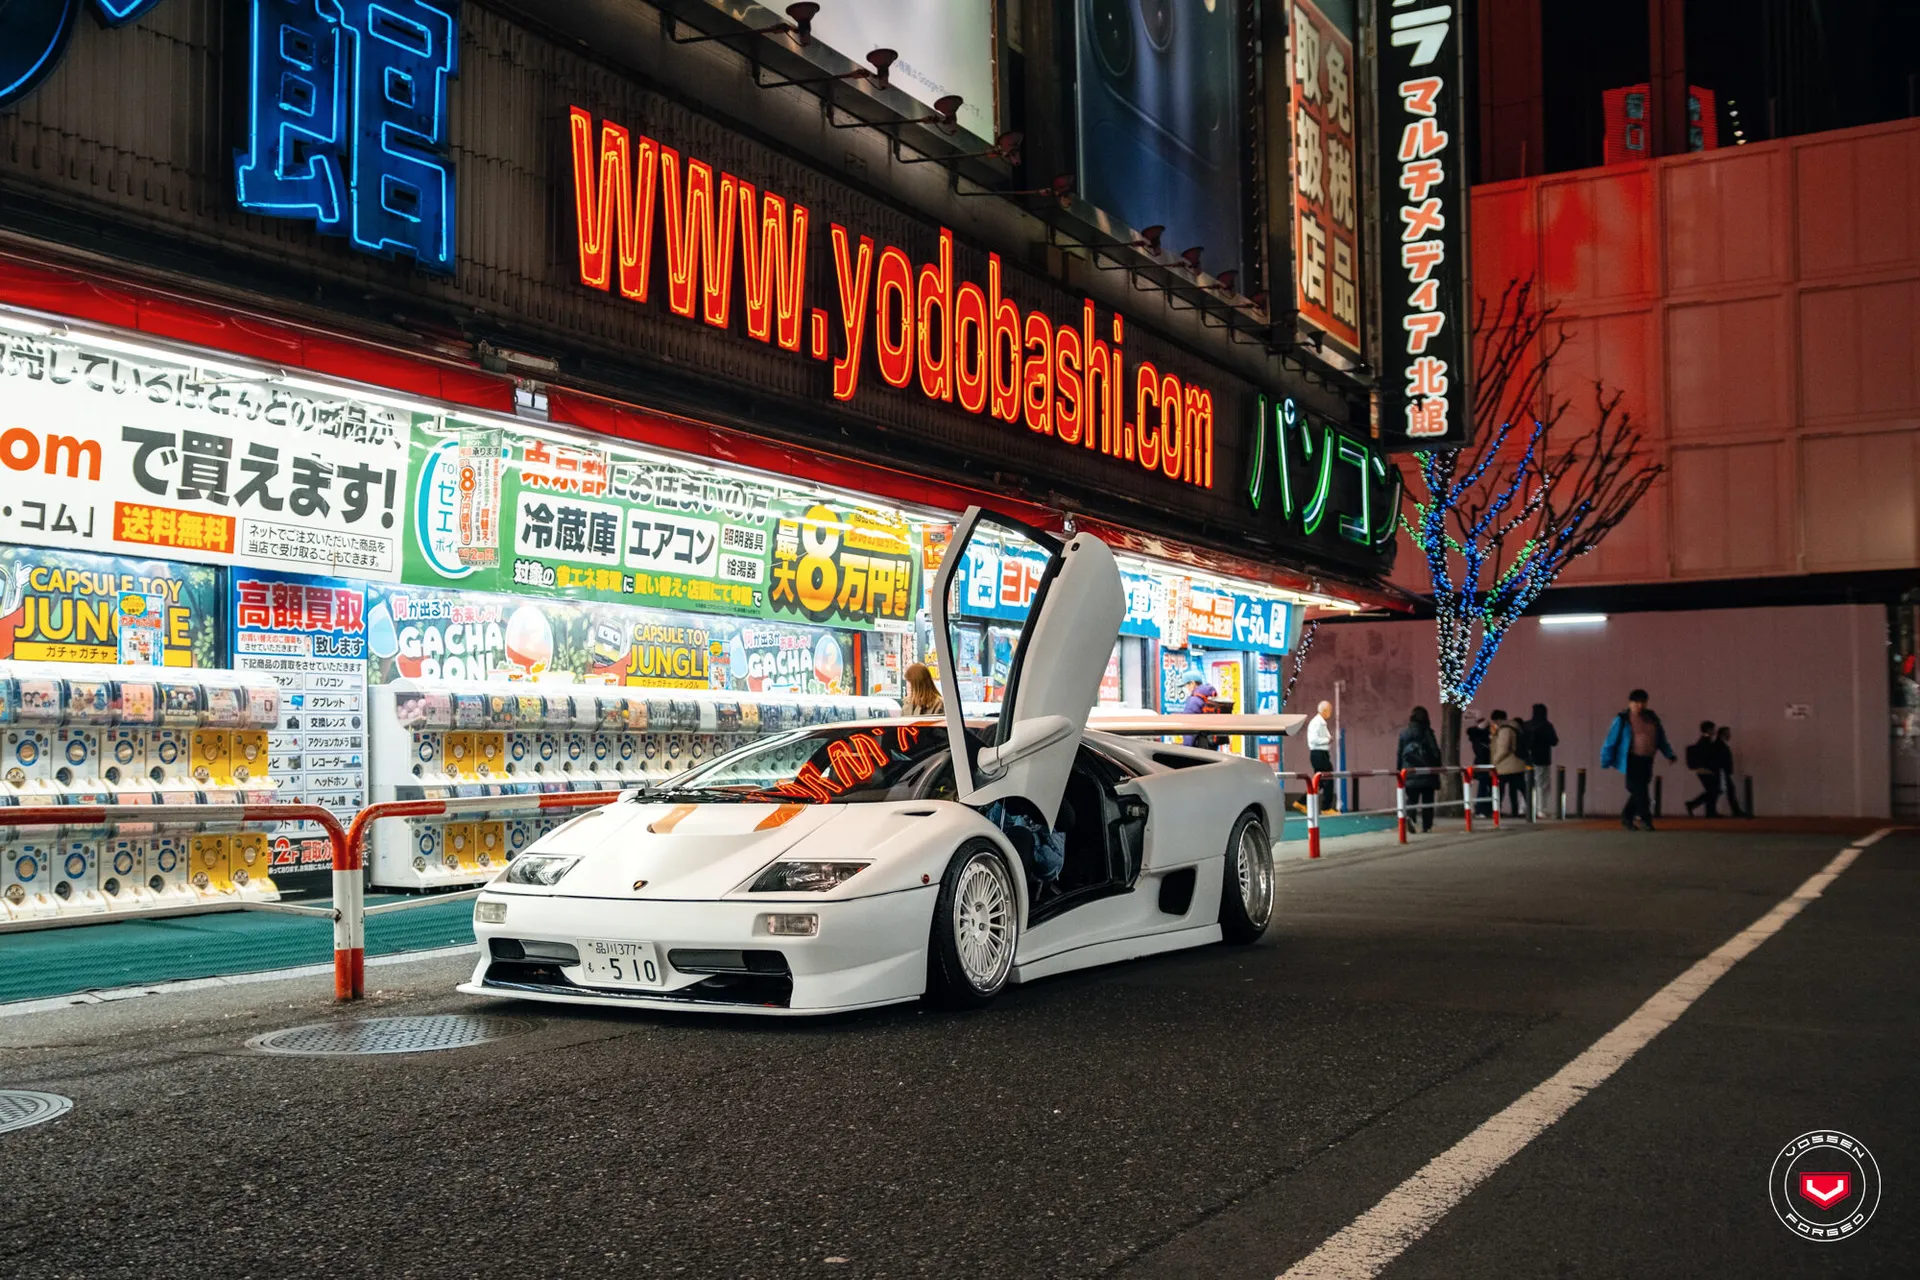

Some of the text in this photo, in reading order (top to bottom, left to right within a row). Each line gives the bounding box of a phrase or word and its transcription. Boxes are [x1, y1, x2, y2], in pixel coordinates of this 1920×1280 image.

[1390, 0, 1451, 67] ラ
[233, 0, 457, 275] 館
[1292, 2, 1326, 312] 取扱店
[1326, 40, 1358, 330] 免税品
[569, 104, 1214, 490] www.yodobashi.com
[121, 425, 398, 530] で買えます!
[1248, 393, 1401, 554] パソコン
[120, 505, 228, 551] 送料無料
[250, 525, 386, 553] ネットでご注文いただいた商品を
[522, 502, 716, 565] 冷蔵庫 エアコン
[724, 528, 764, 551] 照明器具
[249, 540, 379, 567] 当店で受け取ることもできます。
[30, 566, 134, 597] CAPSULE
[138, 576, 183, 603] TOY
[14, 596, 192, 647] JUNE
[237, 581, 365, 634] 高額買取
[315, 635, 365, 658] 致します
[399, 621, 504, 657] GACHA
[633, 623, 710, 646] CAPSULE TOY
[241, 658, 362, 672] 下記商品の買取をさせていただきます
[748, 648, 813, 679] GACHA
[315, 677, 344, 688] パソコン
[312, 696, 346, 708] タブレット
[310, 716, 347, 728] 交換レンズ
[307, 738, 350, 748] アクションカメラ
[311, 757, 347, 768] レコーダー
[314, 776, 348, 787] ヘッドホン
[316, 795, 346, 806] ゲーム機
